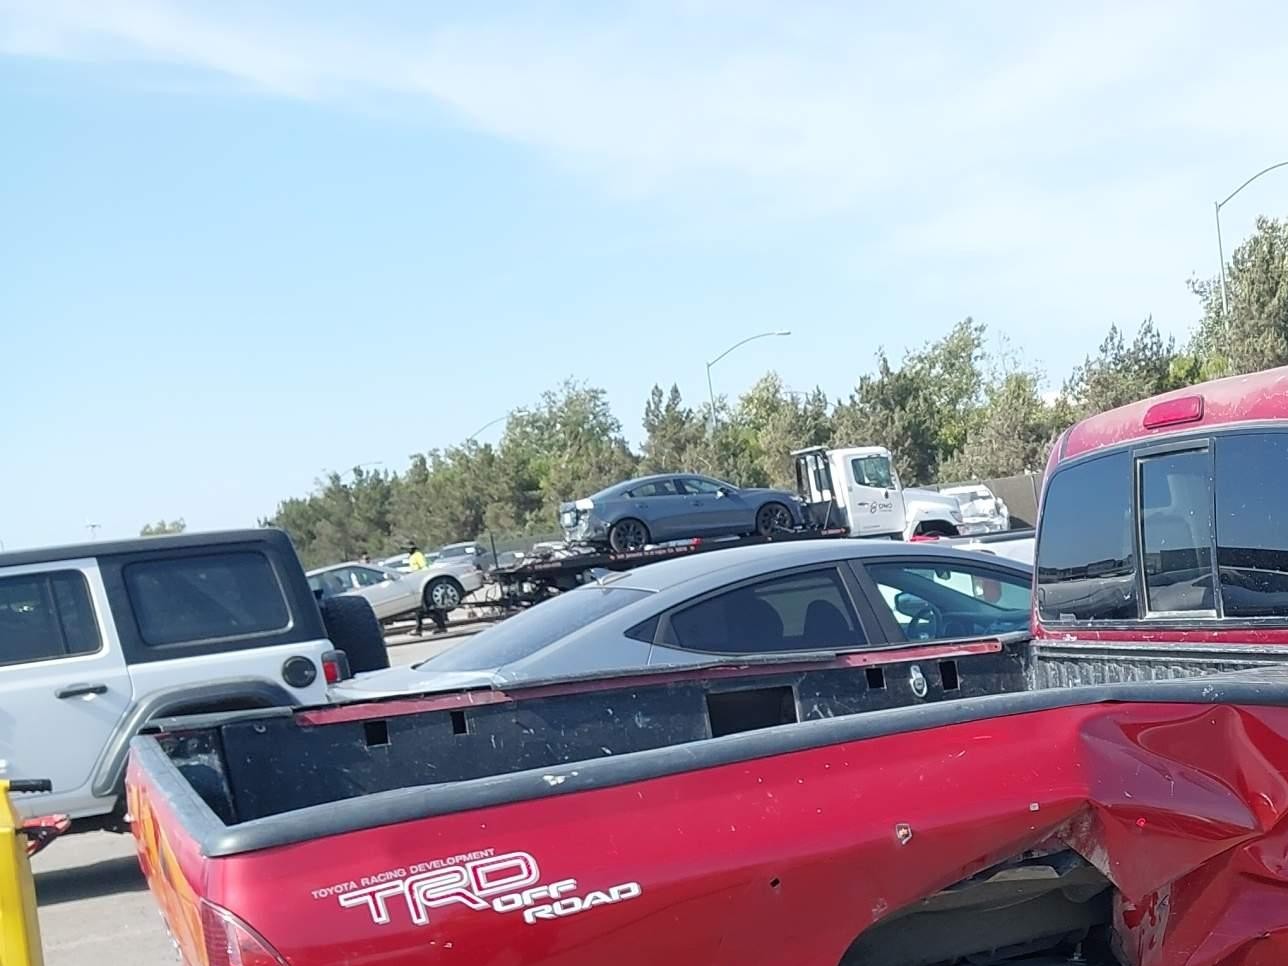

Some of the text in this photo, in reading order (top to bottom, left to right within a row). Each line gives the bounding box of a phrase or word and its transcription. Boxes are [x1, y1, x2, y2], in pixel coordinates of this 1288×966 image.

[311, 848, 496, 899] TOYOTA RACING DEVELOPMENT
[338, 851, 540, 926] TRD
[491, 878, 577, 913] OFF
[522, 881, 642, 924] ROAD
